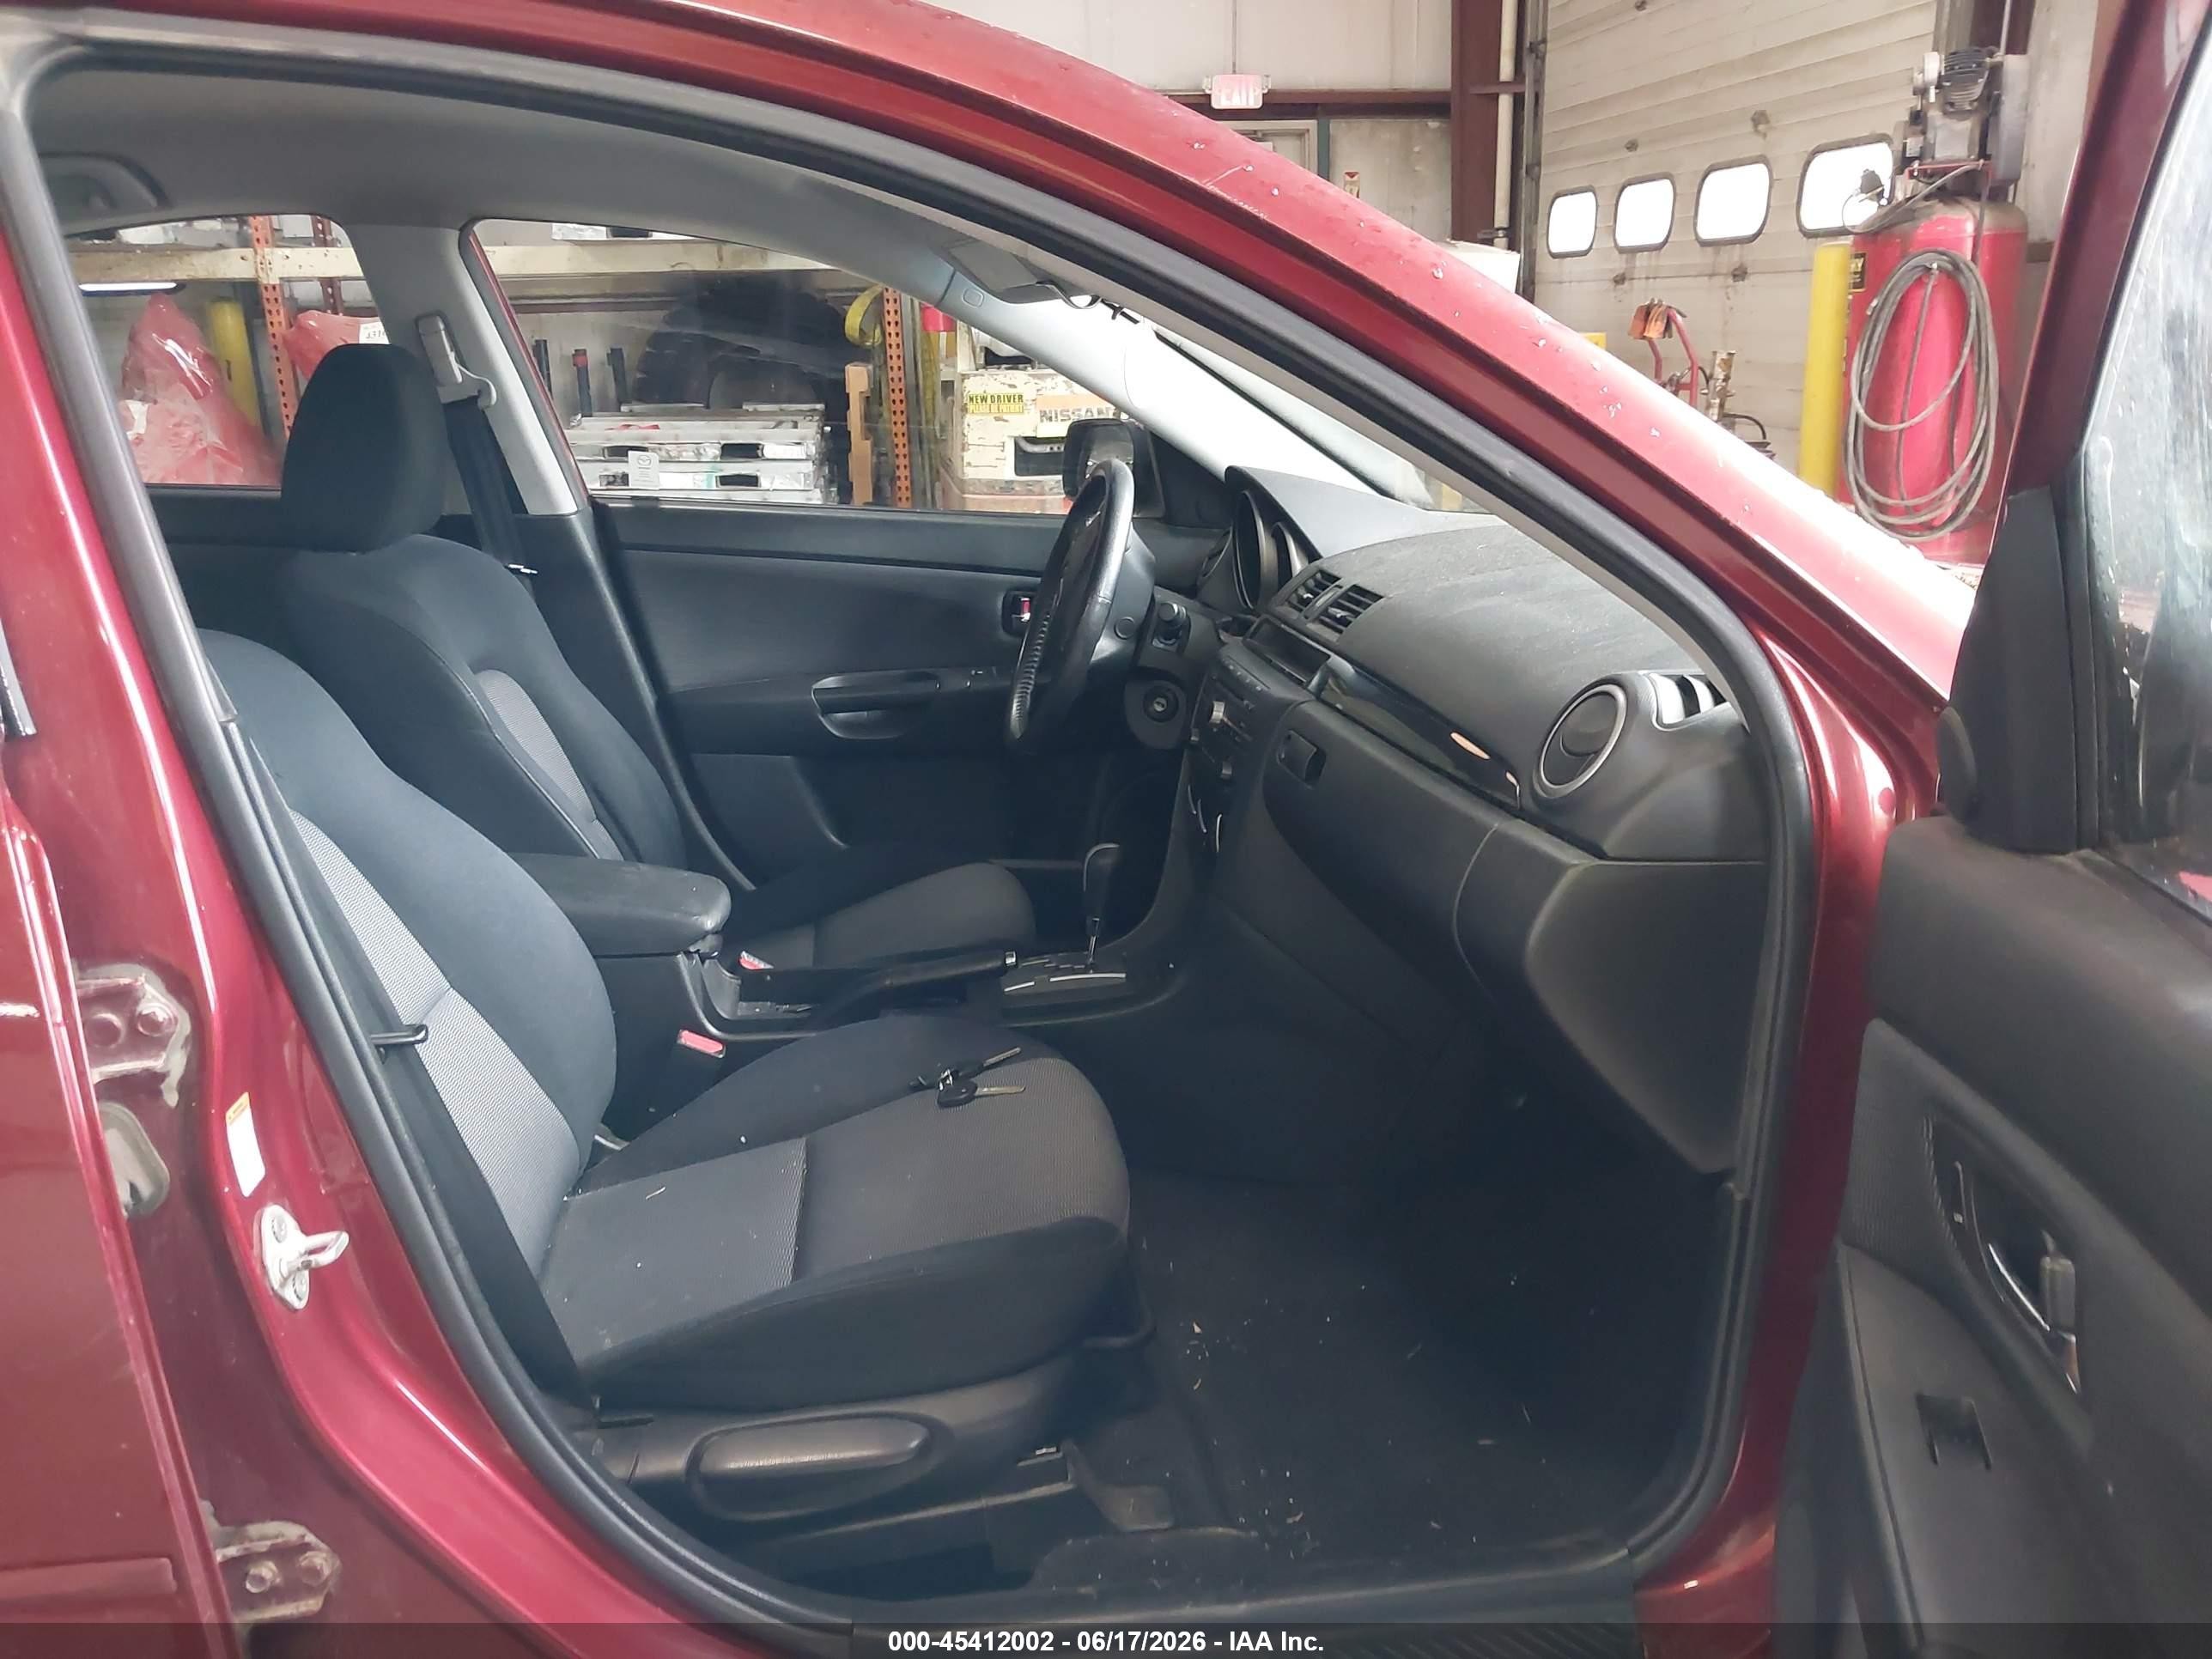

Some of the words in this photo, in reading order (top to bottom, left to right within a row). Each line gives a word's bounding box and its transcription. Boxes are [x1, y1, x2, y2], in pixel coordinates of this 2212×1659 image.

[968, 394, 988, 404] NEW
[990, 393, 1024, 404] DRIVER
[1039, 406, 1114, 422] NISSAN
